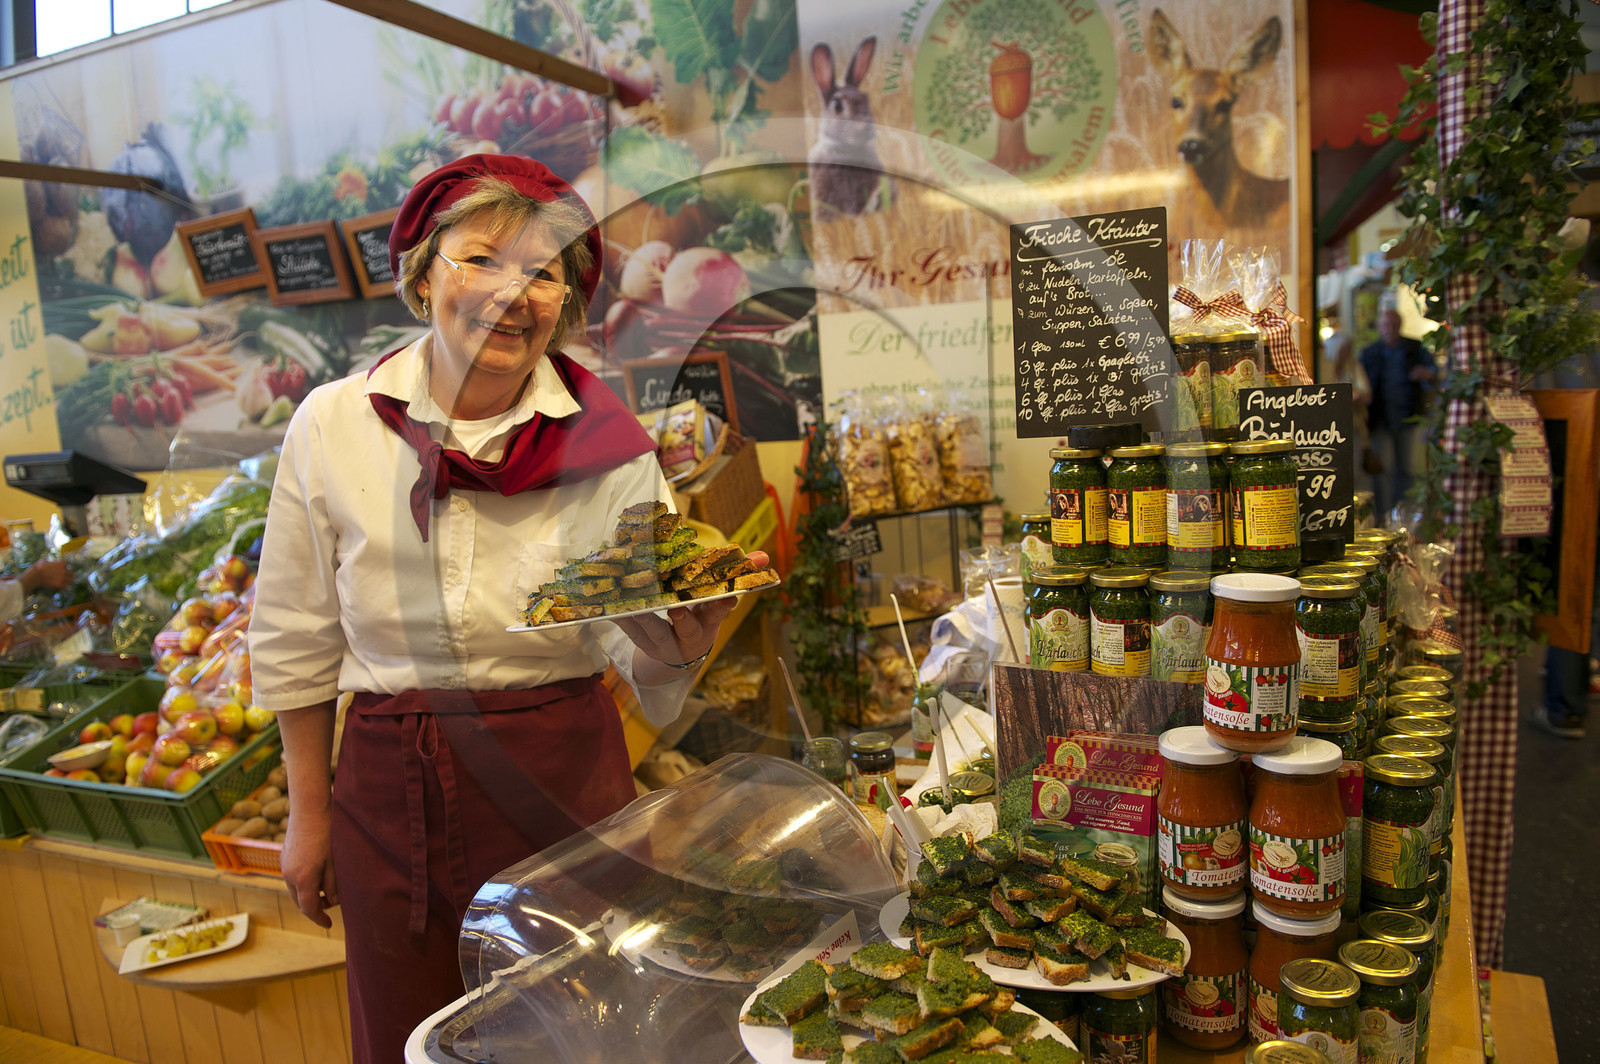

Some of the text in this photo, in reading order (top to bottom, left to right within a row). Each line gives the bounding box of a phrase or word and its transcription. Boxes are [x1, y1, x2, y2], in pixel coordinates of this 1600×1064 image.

[1020, 218, 1159, 248] Frische Kräuter
[836, 256, 905, 293] Ihr
[1029, 290, 1058, 308] auf's
[1028, 309, 1048, 319] zum
[1055, 303, 1095, 317] Würzen
[1102, 302, 1114, 313] in
[10, 301, 36, 350] ist
[1042, 319, 1086, 334] Suppen,
[847, 319, 906, 356] Der
[1018, 341, 1027, 354] 1
[1031, 341, 1052, 357] Glas
[1019, 360, 1031, 375] 3
[1021, 377, 1030, 391] 4
[1130, 360, 1167, 385] gratis
[1021, 393, 1031, 407] 6
[1086, 386, 1095, 400] 1
[1099, 384, 1125, 401] Glas
[1018, 409, 1033, 421] 10
[1091, 401, 1103, 414] 2
[1119, 754, 1159, 772] Gesund
[1104, 793, 1145, 812] Gesund
[1251, 870, 1319, 900] Tomatensoße
[831, 929, 852, 951] Keine
